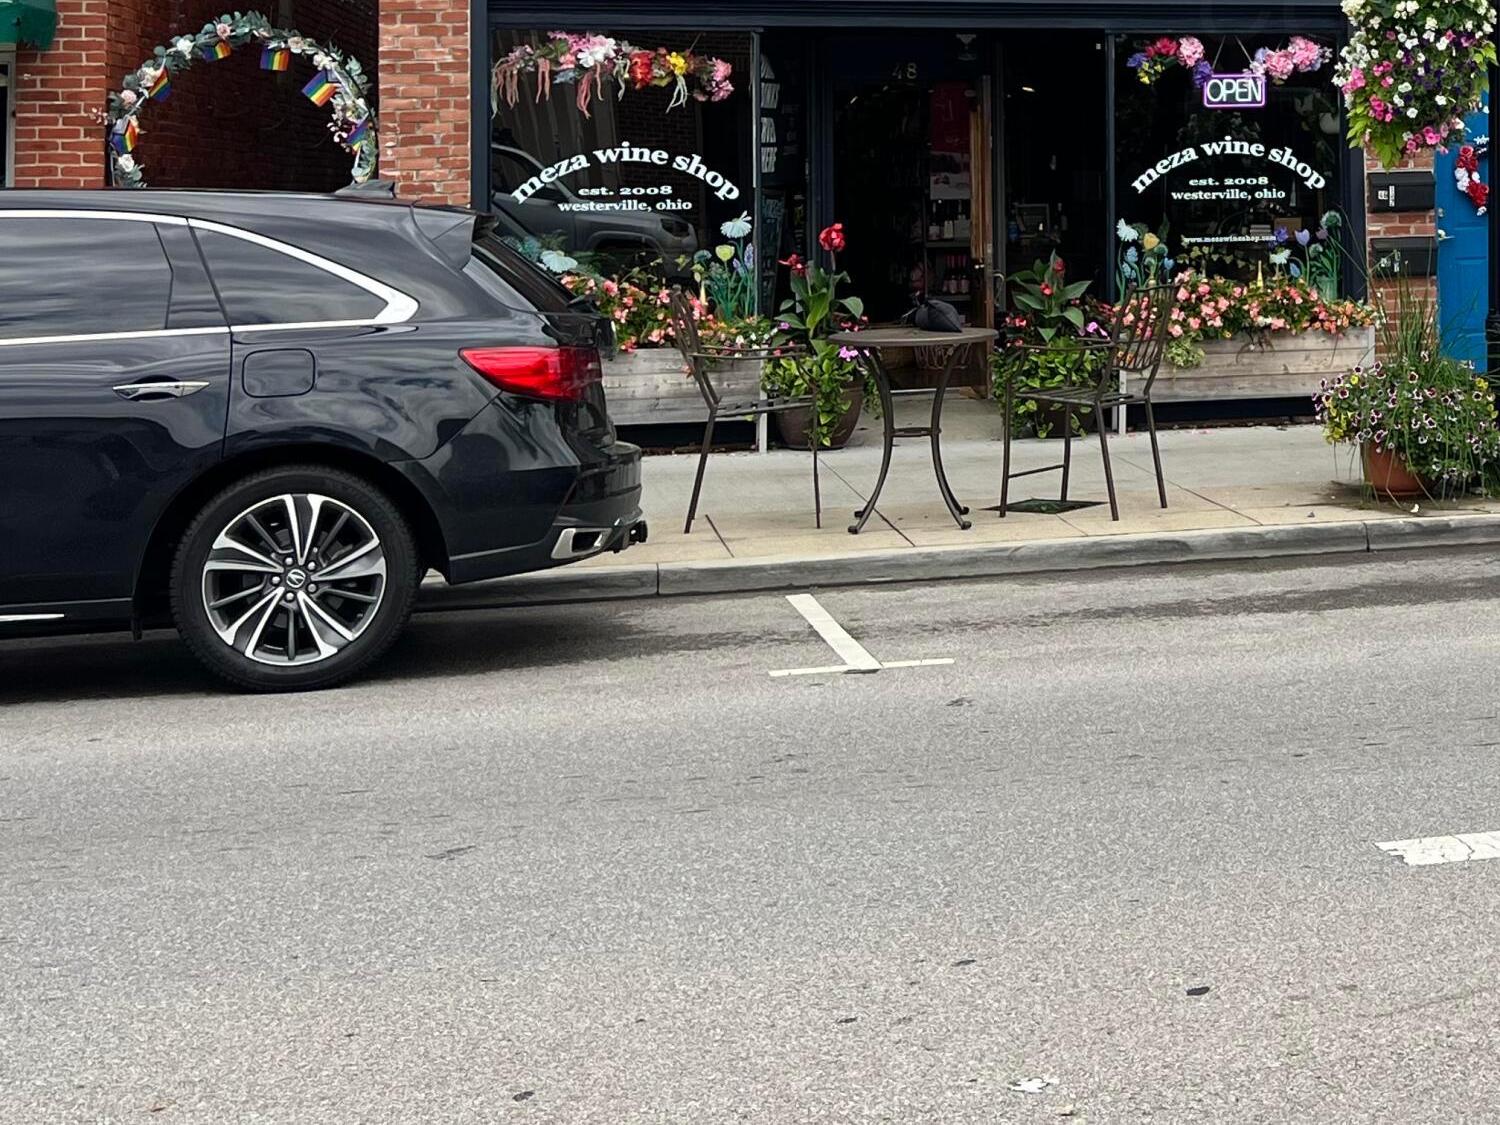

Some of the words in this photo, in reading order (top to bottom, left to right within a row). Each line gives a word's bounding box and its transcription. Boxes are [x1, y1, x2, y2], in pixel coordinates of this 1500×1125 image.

[893, 62, 917, 80] 48
[1207, 78, 1262, 102] OPEN
[1131, 147, 1199, 194] meza
[1201, 135, 1265, 157] wine
[1268, 147, 1326, 190] shop
[510, 153, 590, 204] meza
[592, 141, 670, 166] wine
[672, 153, 740, 201] shop
[1189, 177, 1219, 186] est.
[1224, 176, 1269, 186] 2008
[578, 186, 614, 196] est.
[619, 185, 673, 196] 2008
[1171, 188, 1252, 201] westerville,
[1254, 188, 1286, 199] ohio
[557, 200, 651, 212] westerville,
[656, 199, 693, 210] ohio
